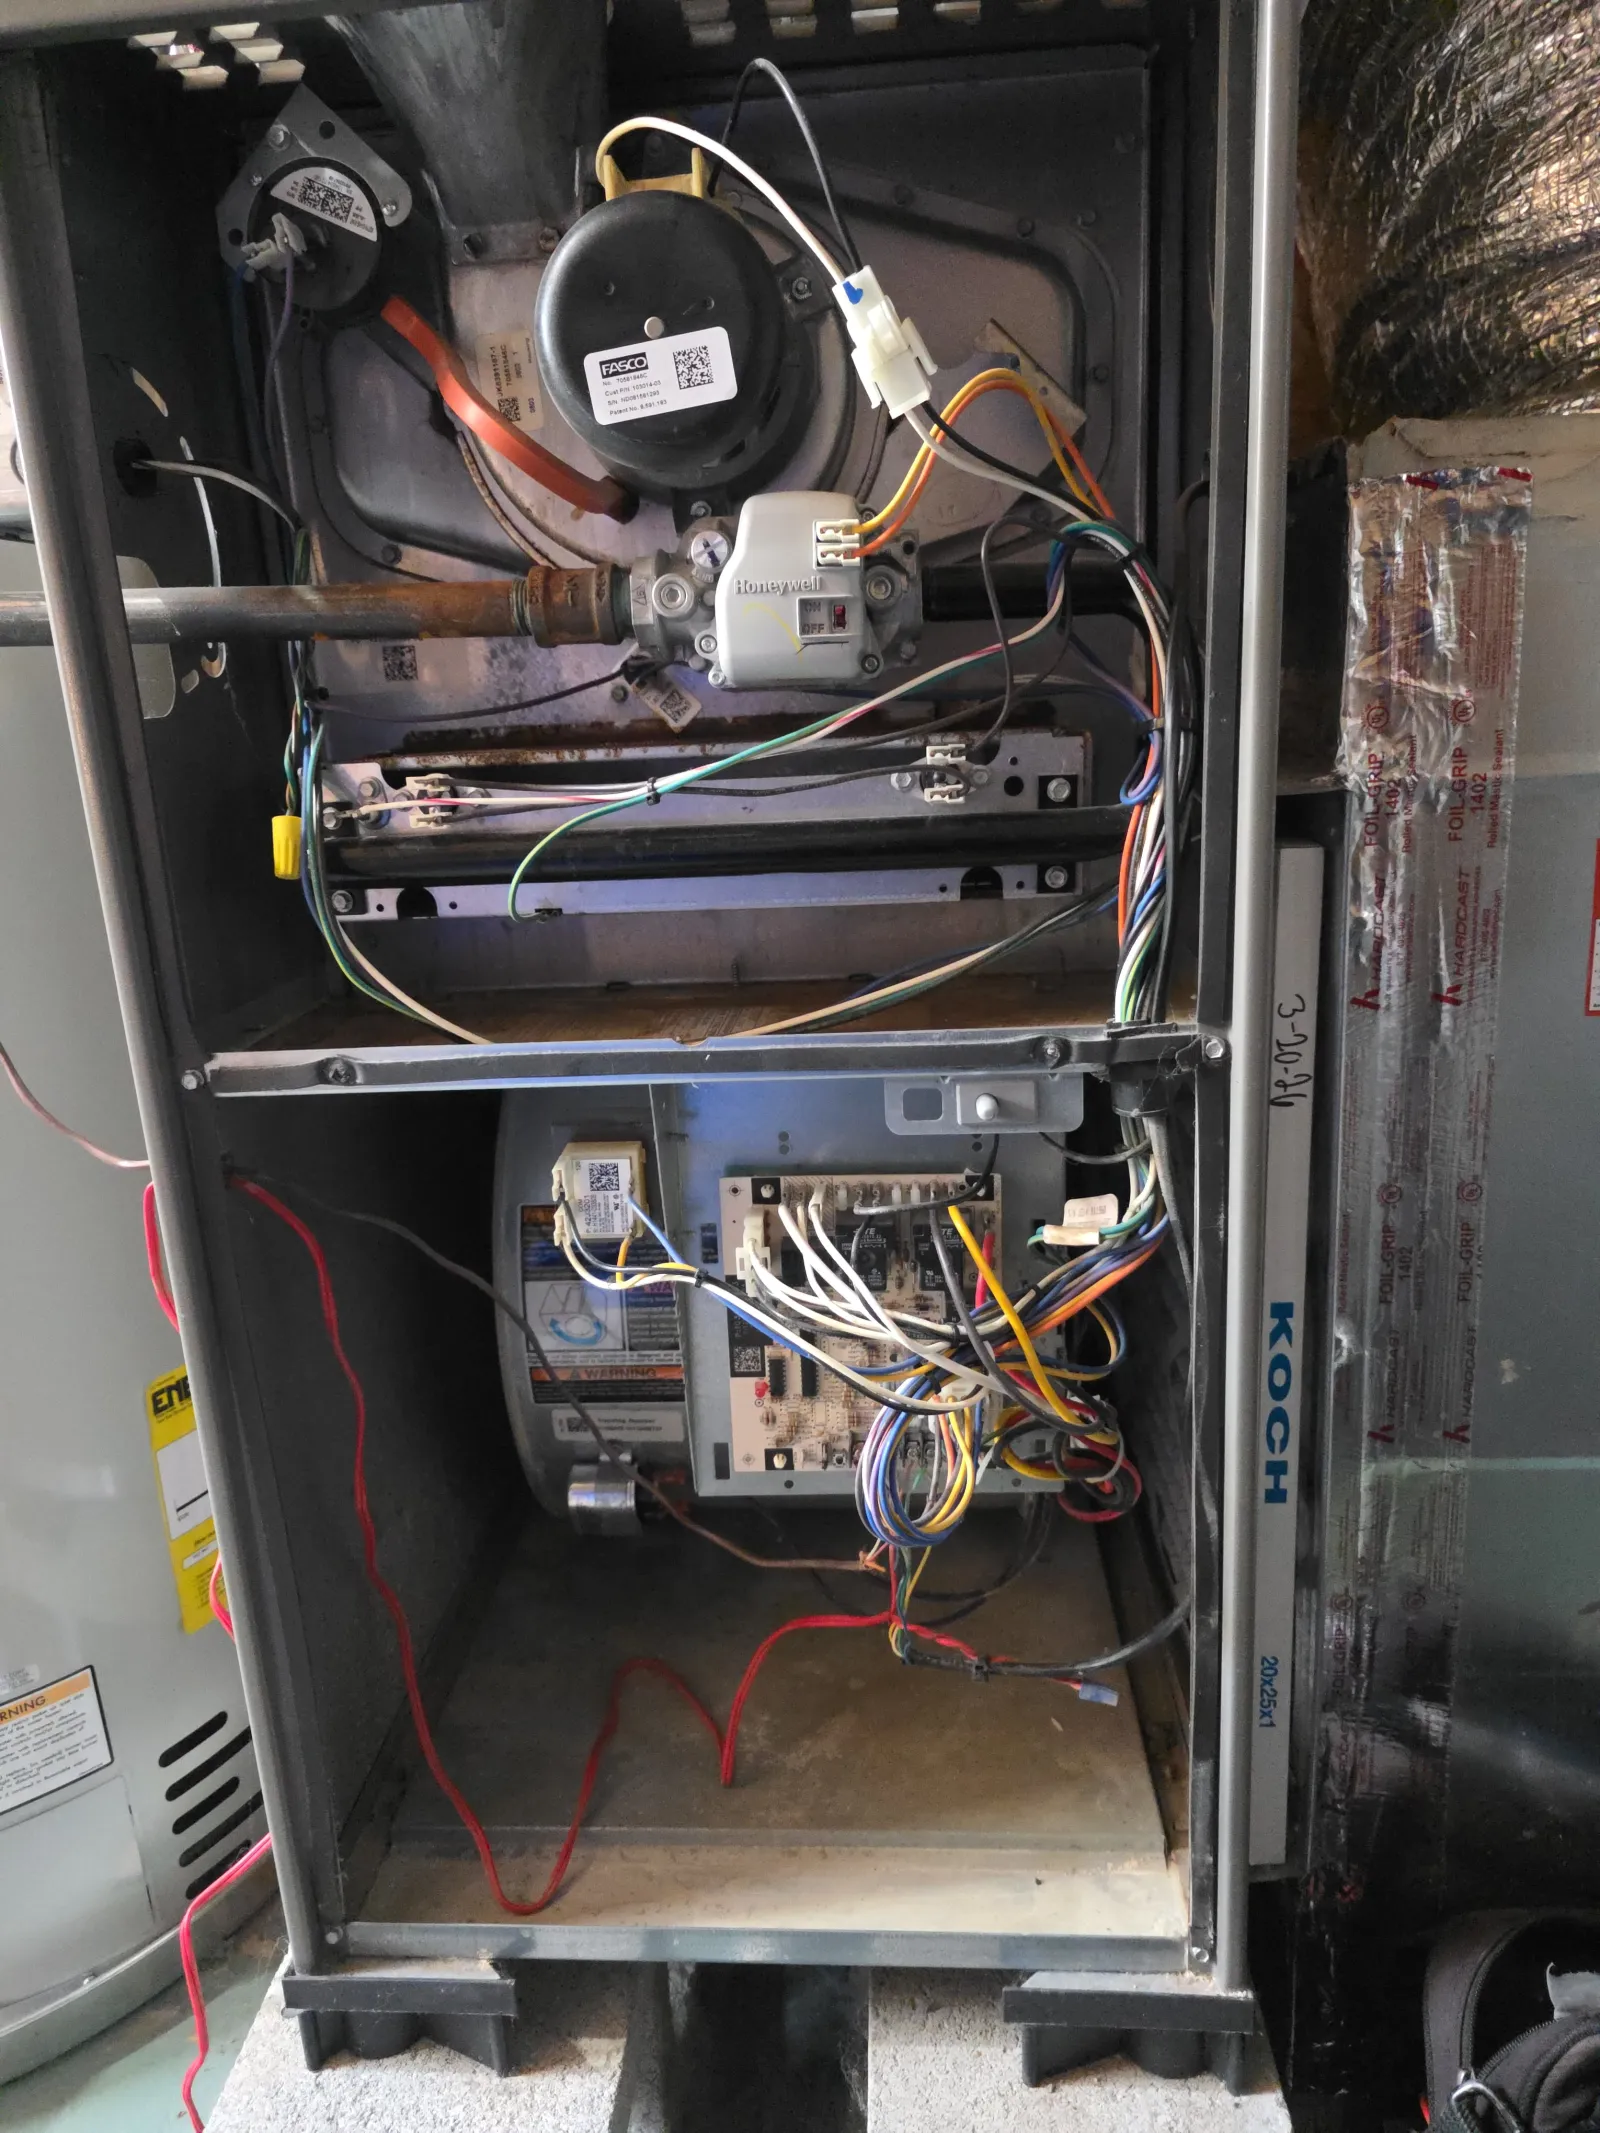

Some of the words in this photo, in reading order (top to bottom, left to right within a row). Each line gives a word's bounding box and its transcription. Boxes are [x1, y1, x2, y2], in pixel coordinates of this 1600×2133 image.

[601, 356, 648, 376] FASCO
[604, 388, 619, 397] Cust
[609, 407, 629, 416] Patent
[734, 576, 822, 596] Honeywell
[804, 601, 821, 613] ON
[801, 623, 825, 634] OFF
[1492, 728, 1505, 772] Sealant
[1364, 752, 1384, 847] FOIL-GRIP
[1385, 777, 1401, 817] 1402
[1447, 746, 1468, 842] FOIL-GRIP
[1470, 772, 1487, 814] 1402
[1488, 773, 1502, 811] Mastic
[1402, 819, 1413, 854] Rolled
[1486, 813, 1500, 848] Rolled
[1371, 873, 1385, 982] HARDCAST
[1453, 865, 1470, 977] HARDCAST
[1379, 1223, 1397, 1305] FOIL-GRIP
[1398, 1245, 1413, 1281] 1402
[1456, 1221, 1474, 1303] FOIL-GRIP
[585, 1367, 657, 1380] WARNING
[1386, 1329, 1400, 1419] HARDCAST
[1462, 1325, 1477, 1418] HARDCAST
[1264, 1301, 1294, 1504] KOCH
[1259, 1656, 1279, 1728] 20x25x1
